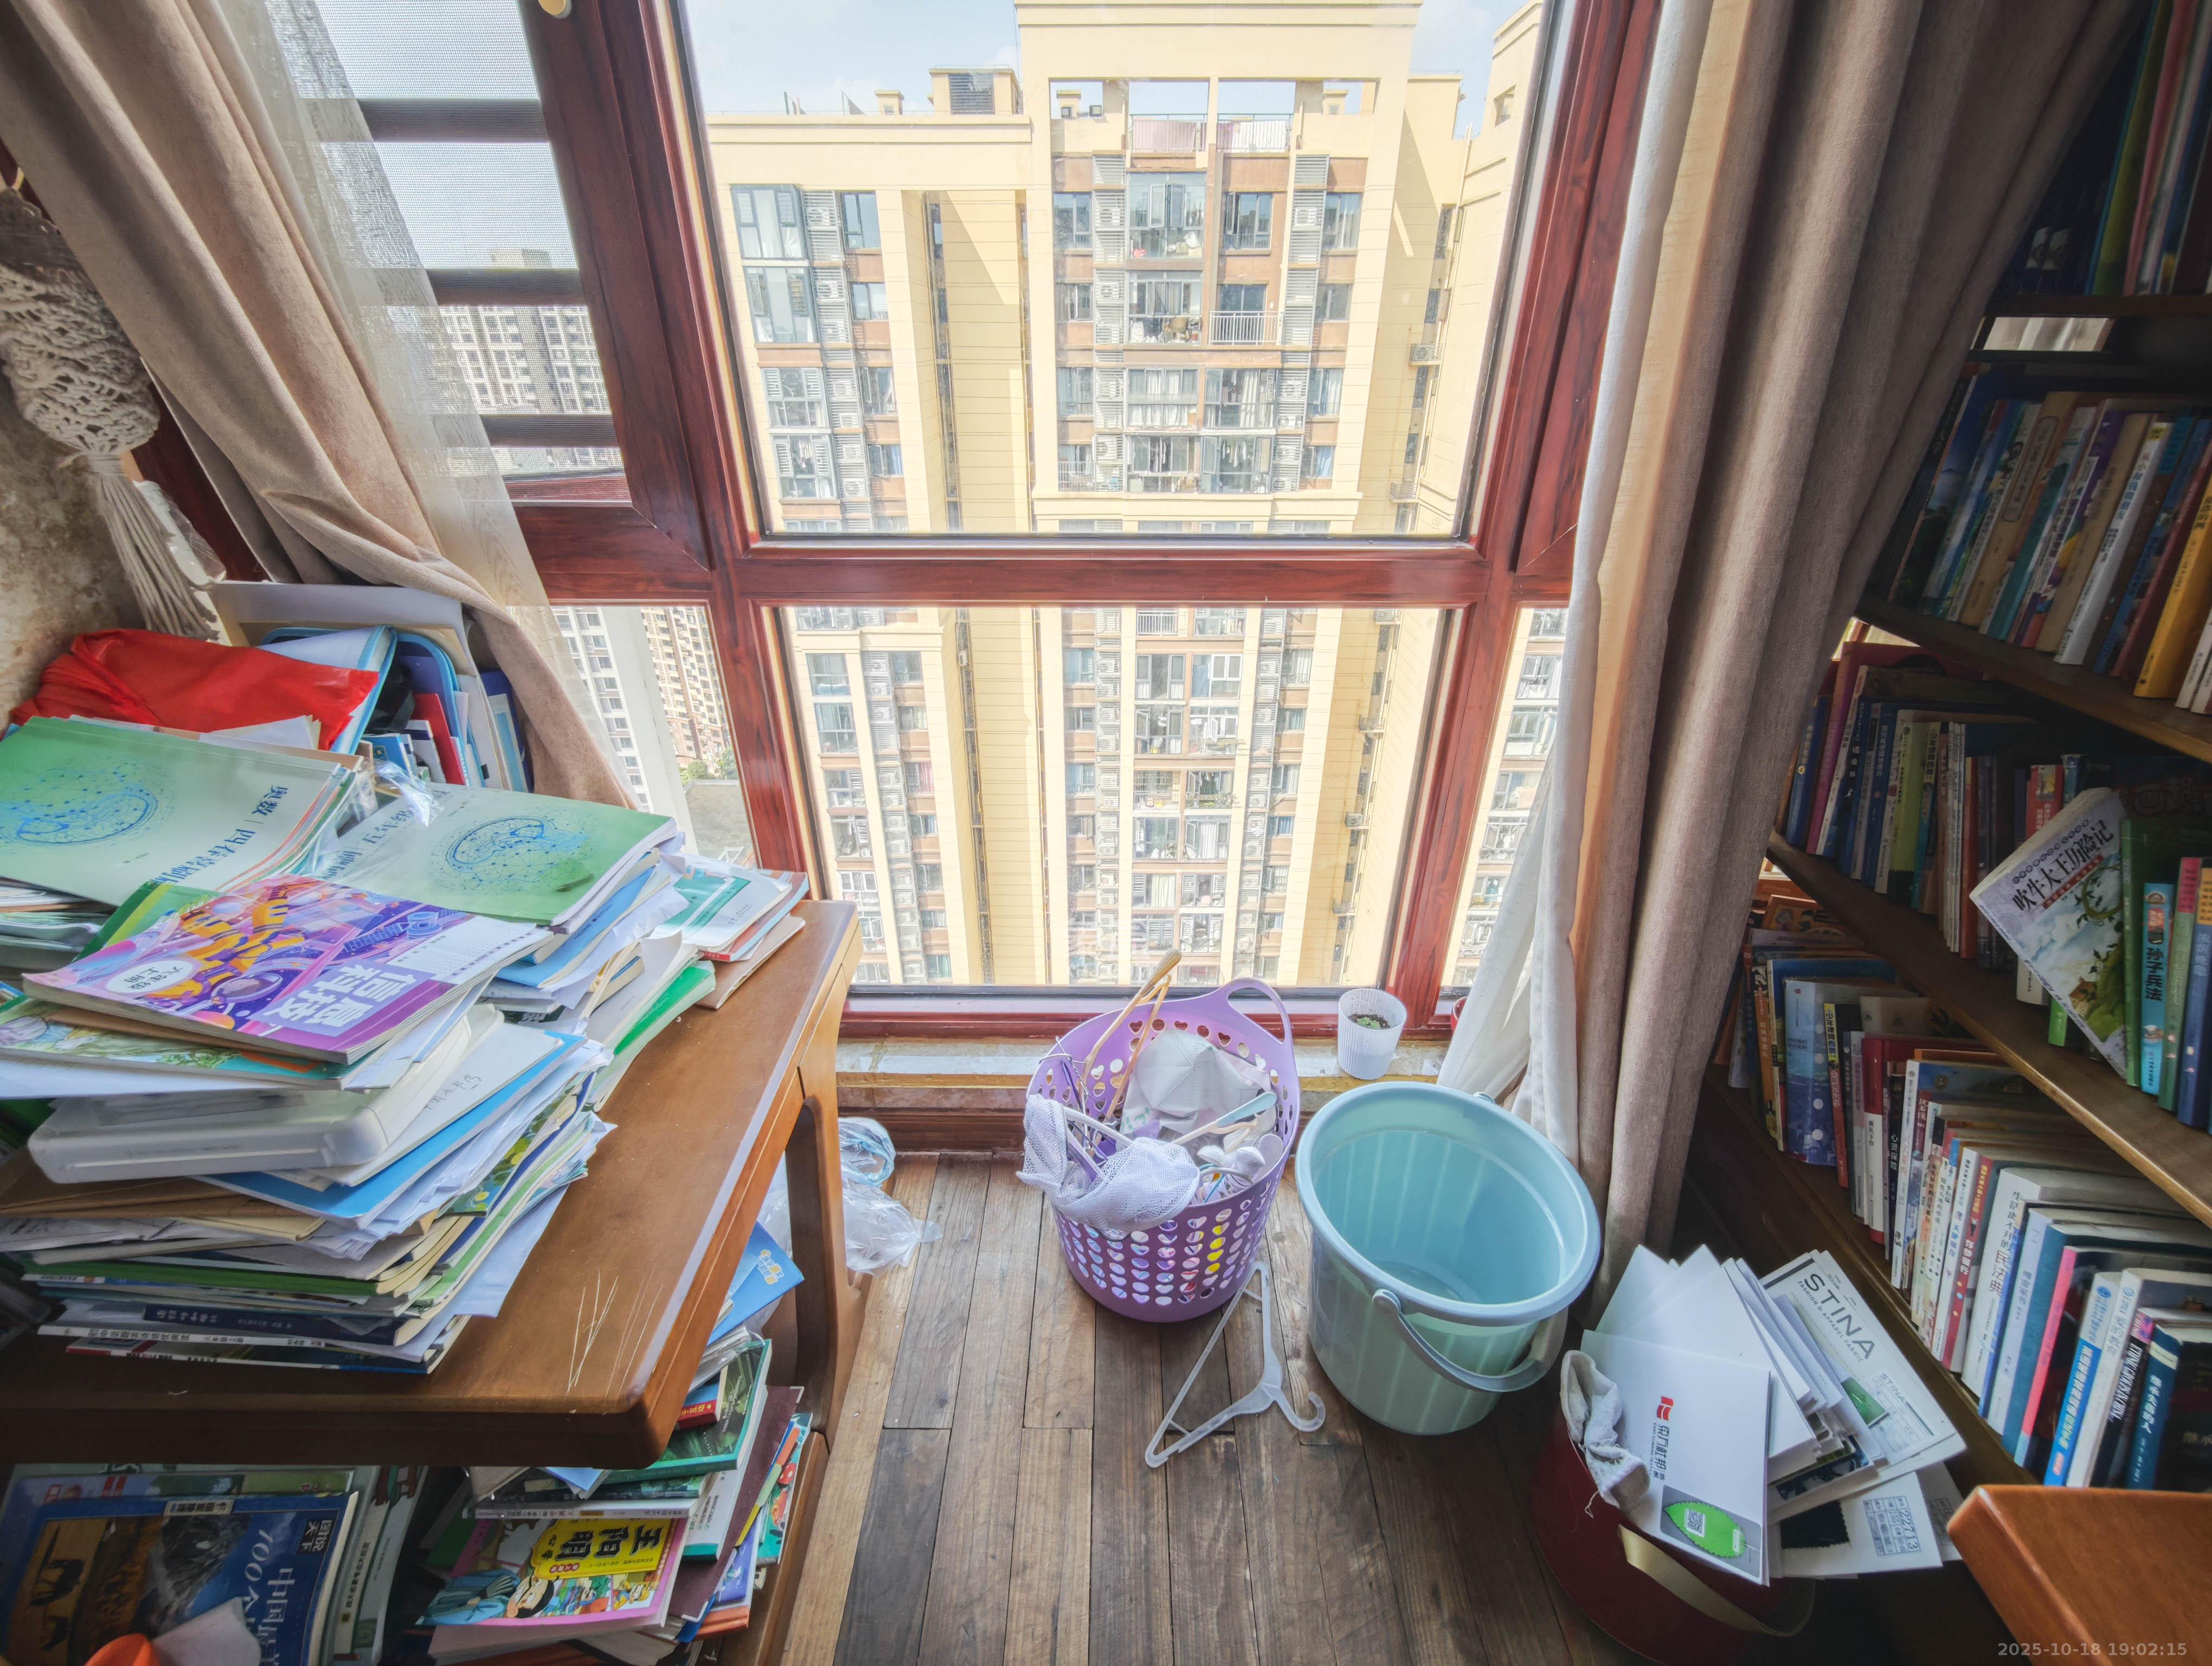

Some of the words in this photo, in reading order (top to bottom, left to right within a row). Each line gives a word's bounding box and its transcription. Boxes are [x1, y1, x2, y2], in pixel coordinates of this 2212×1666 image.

[252, 785, 289, 816] 奥数
[2011, 819, 2114, 912] 吹牛大王历险记
[123, 966, 155, 983] 上册
[130, 966, 184, 990] 六年级
[261, 964, 383, 1022] 科技
[2145, 947, 2164, 1001] 孙子兵法
[303, 972, 417, 1027] 信息
[1797, 1280, 1819, 1306] FASHION
[1822, 1312, 1844, 1340] APPAREL
[1843, 1340, 1864, 1363] FABRIC
[1804, 1273, 1875, 1360] STINA
[1880, 1373, 1906, 1403] STINA
[301, 1520, 319, 1552] 天下
[313, 1520, 332, 1552] 图说
[555, 1524, 664, 1562] 王阳明
[1899, 1510, 1918, 1549] 22713
